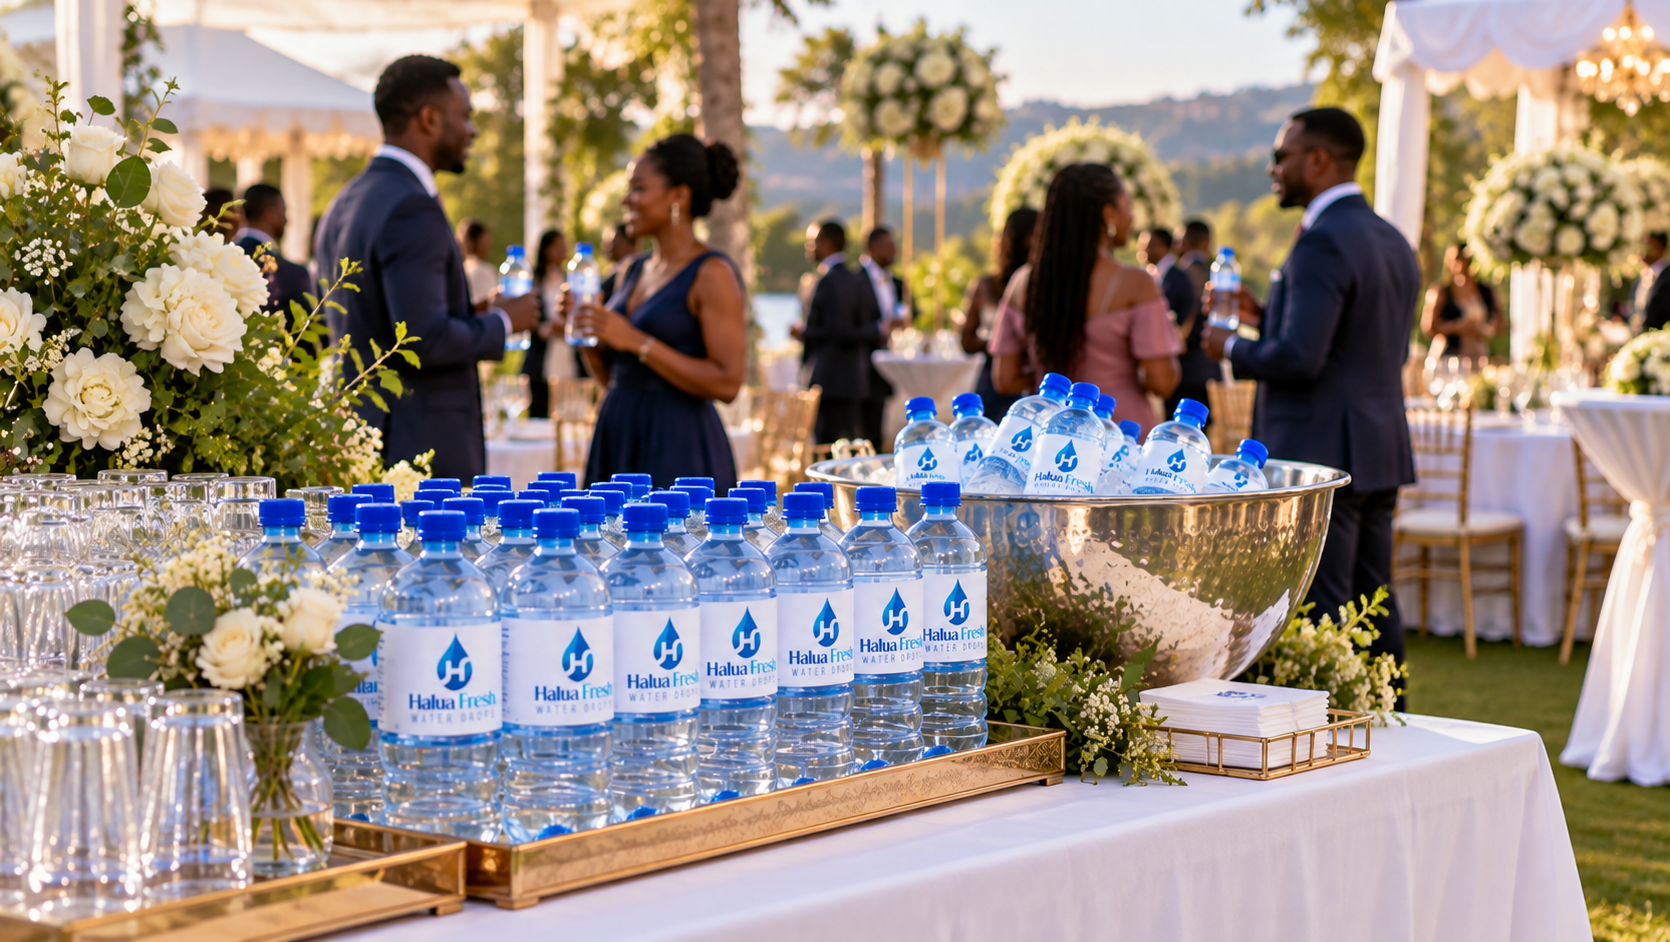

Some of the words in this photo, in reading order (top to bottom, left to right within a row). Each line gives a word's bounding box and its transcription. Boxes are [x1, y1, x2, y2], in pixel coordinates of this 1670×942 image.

[923, 628, 958, 641] Halua
[860, 638, 897, 653] Halua
[925, 643, 957, 653] WATER
[789, 650, 828, 665] Halua
[862, 654, 895, 664] WATER
[707, 661, 748, 676] Halua
[791, 666, 826, 677] WATER
[627, 673, 670, 689] Halua
[709, 679, 746, 689] WATER
[535, 686, 579, 701] Halua
[582, 681, 612, 700] Fresh
[629, 692, 667, 702] WATER
[409, 693, 455, 710] Halua
[459, 690, 496, 709] Fresh
[535, 704, 577, 714] WATER
[411, 713, 453, 724] WATER
[460, 709, 495, 723] DROPS
